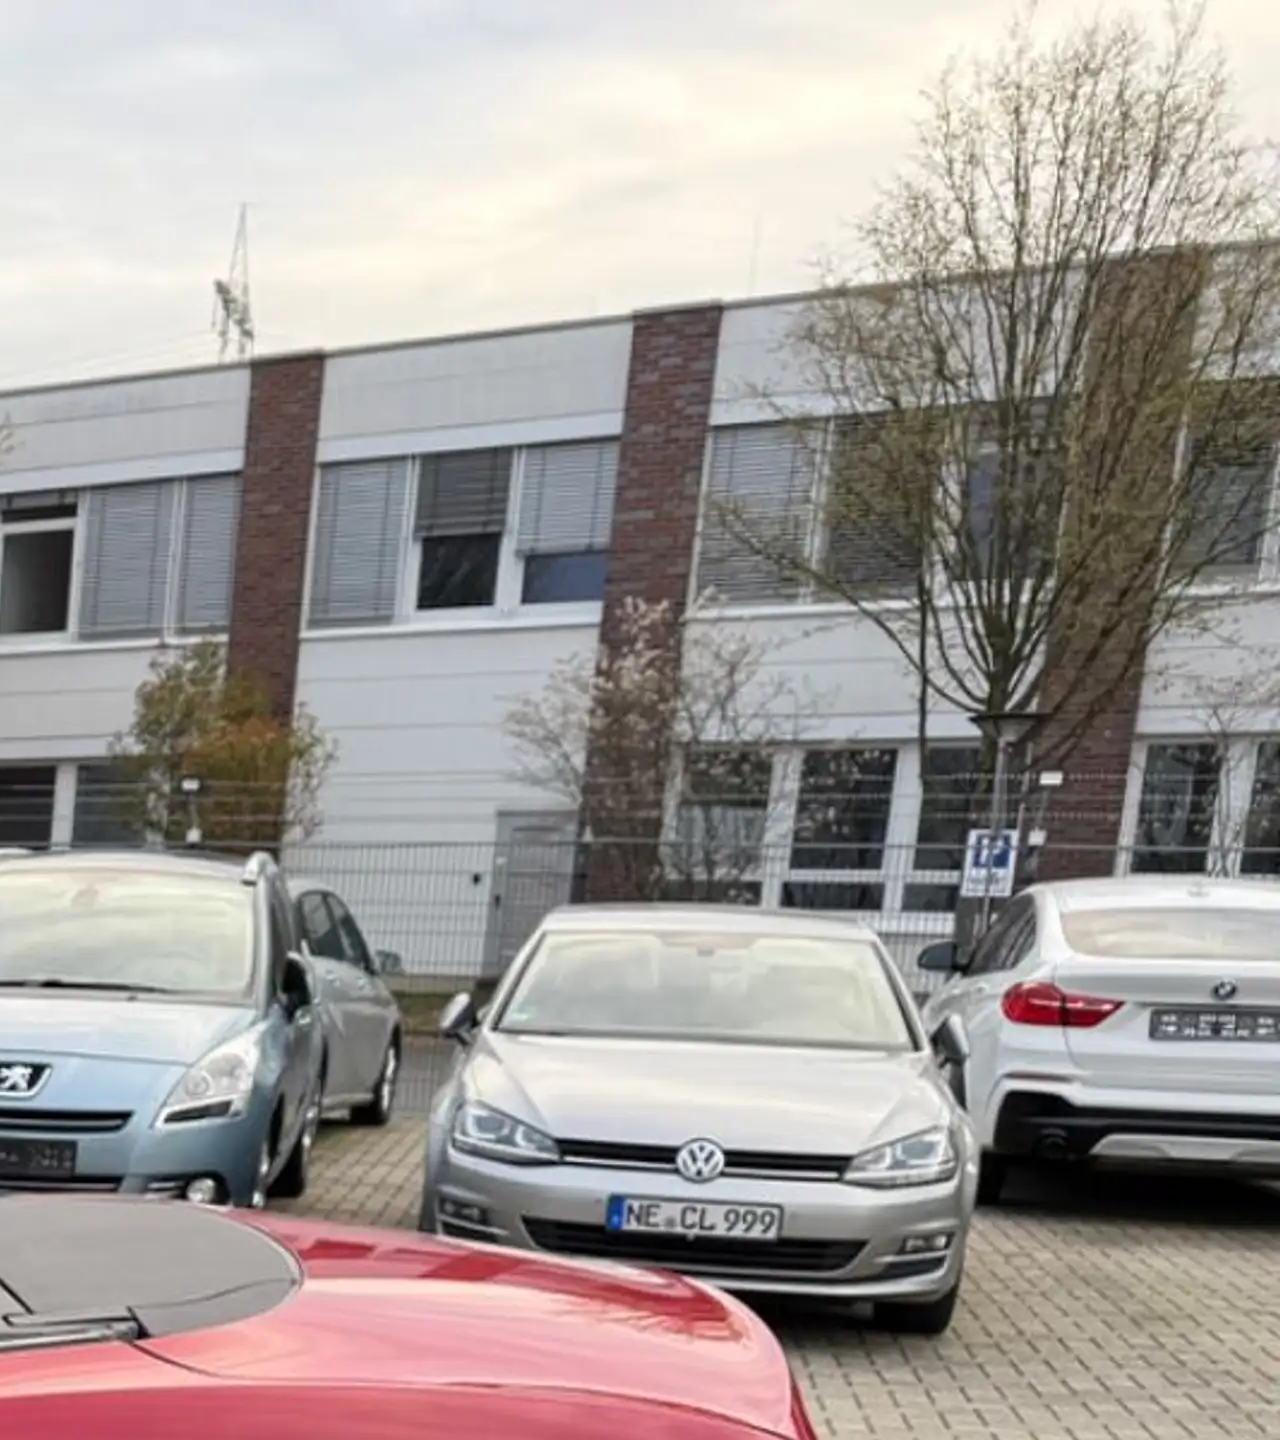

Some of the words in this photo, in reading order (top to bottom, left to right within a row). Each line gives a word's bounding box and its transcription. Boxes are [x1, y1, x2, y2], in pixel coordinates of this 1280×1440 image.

[626, 1203, 662, 1228] NE
[680, 1205, 716, 1231] CL
[724, 1208, 776, 1234] 999
